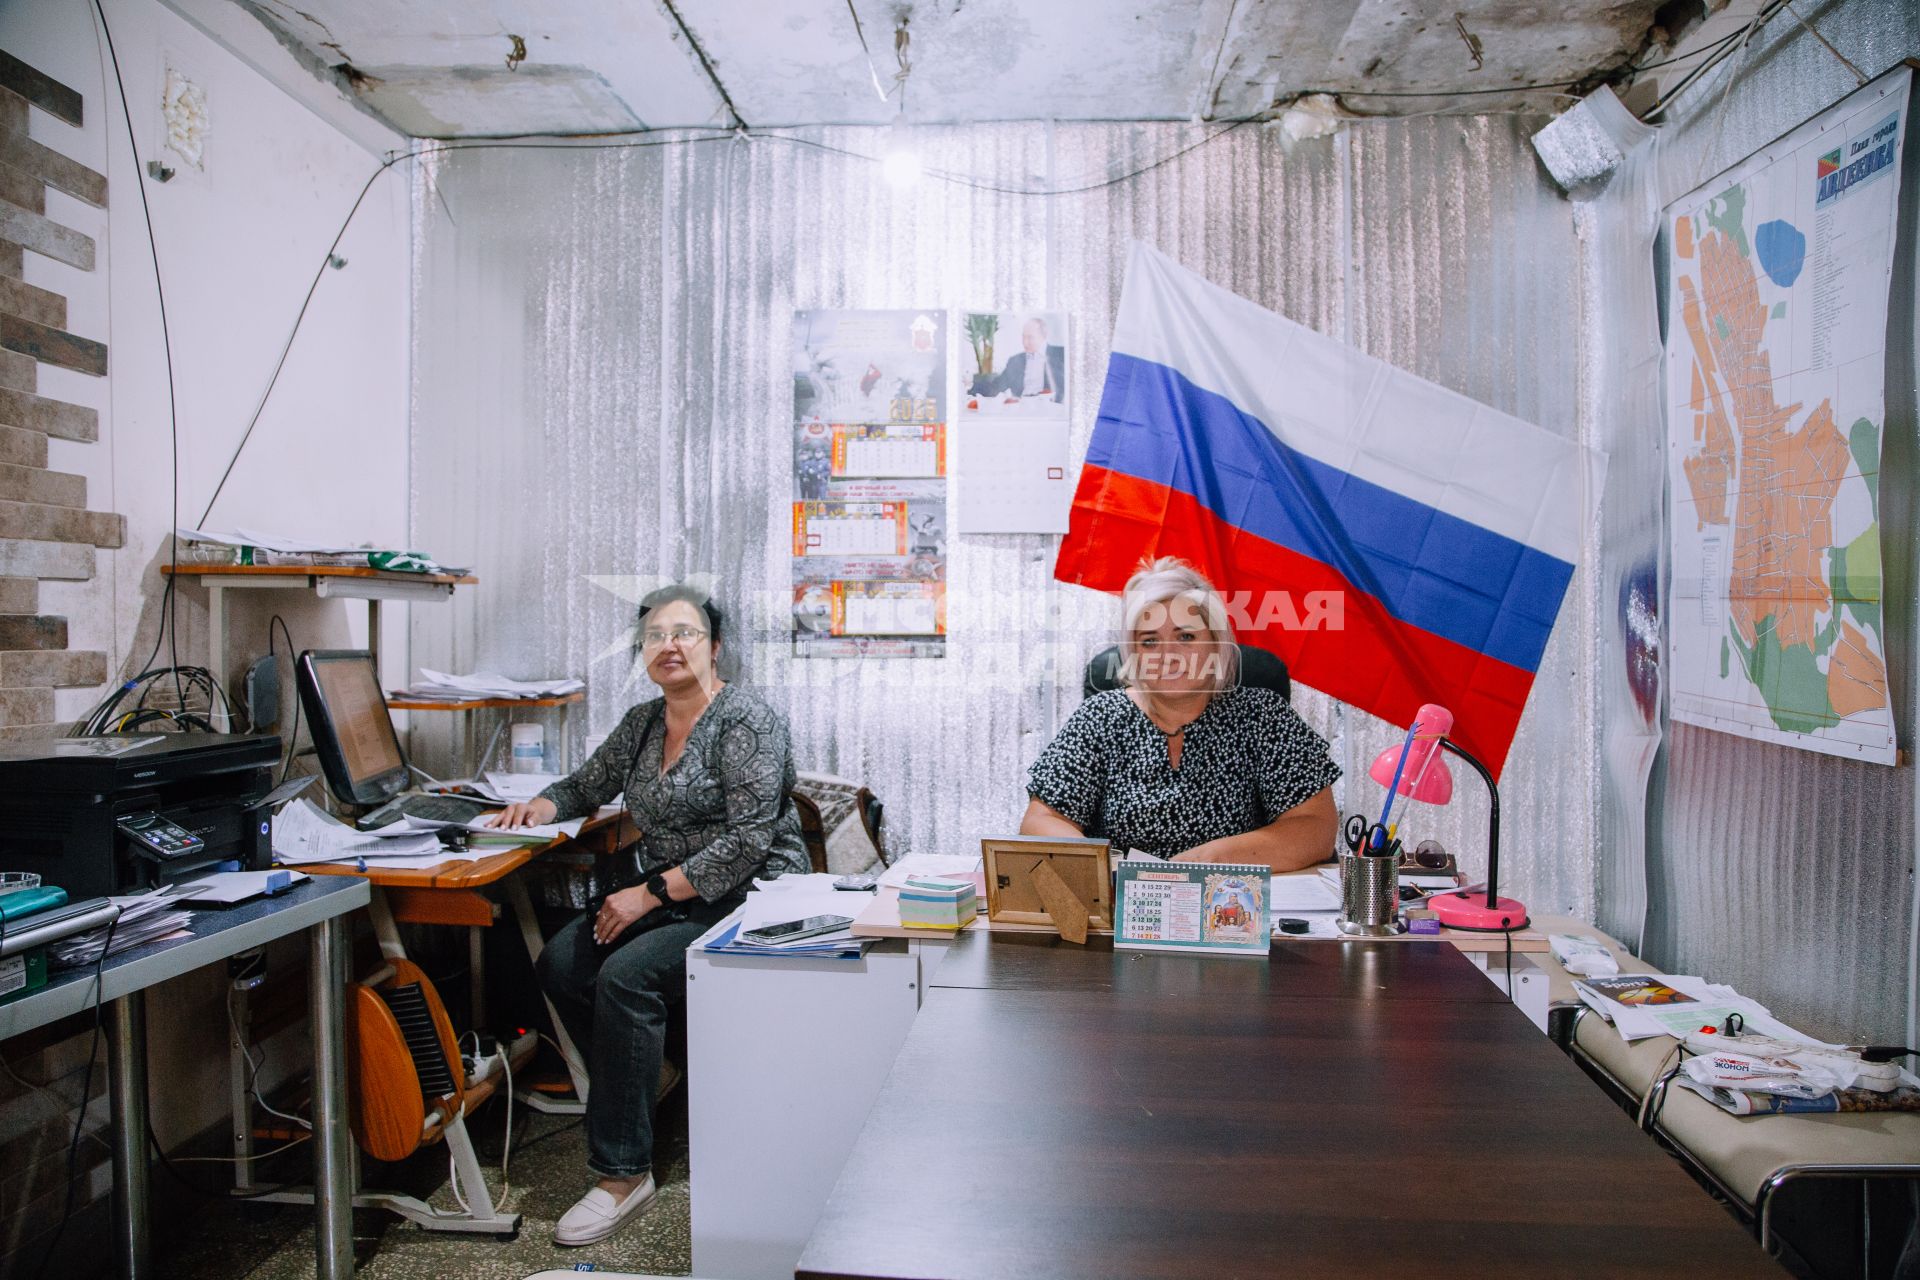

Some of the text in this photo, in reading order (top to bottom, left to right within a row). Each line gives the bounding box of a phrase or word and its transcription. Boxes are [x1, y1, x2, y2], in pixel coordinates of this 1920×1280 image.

[1850, 120, 1897, 156] План города
[889, 399, 937, 420] 2025
[1600, 981, 1650, 989] Sports
[1714, 1061, 1750, 1072] ЭКОНОМ
